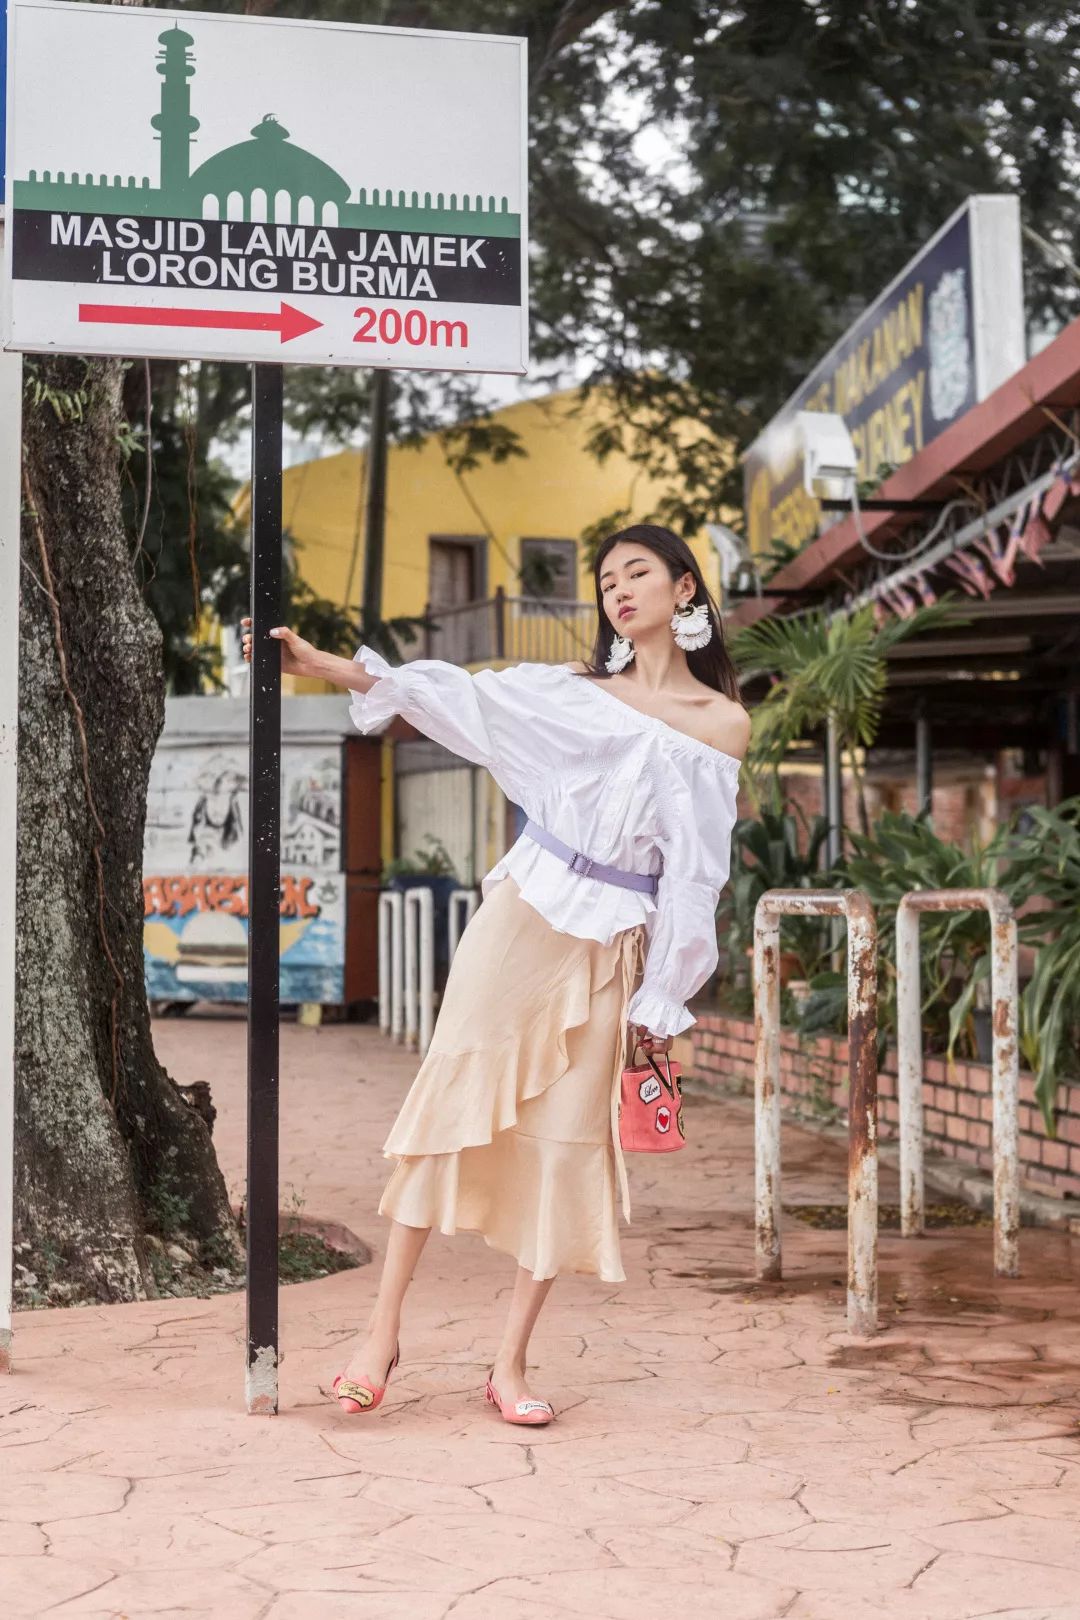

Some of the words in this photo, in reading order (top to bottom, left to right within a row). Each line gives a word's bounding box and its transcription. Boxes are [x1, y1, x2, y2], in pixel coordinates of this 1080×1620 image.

[51, 215, 205, 251] MASJID
[222, 224, 336, 260] LAMA
[348, 232, 486, 268] JAMEK
[103, 251, 277, 289] LORONG
[293, 261, 437, 298] BURMA
[353, 307, 467, 347] 200m
[834, 282, 923, 415] MAKANAN
